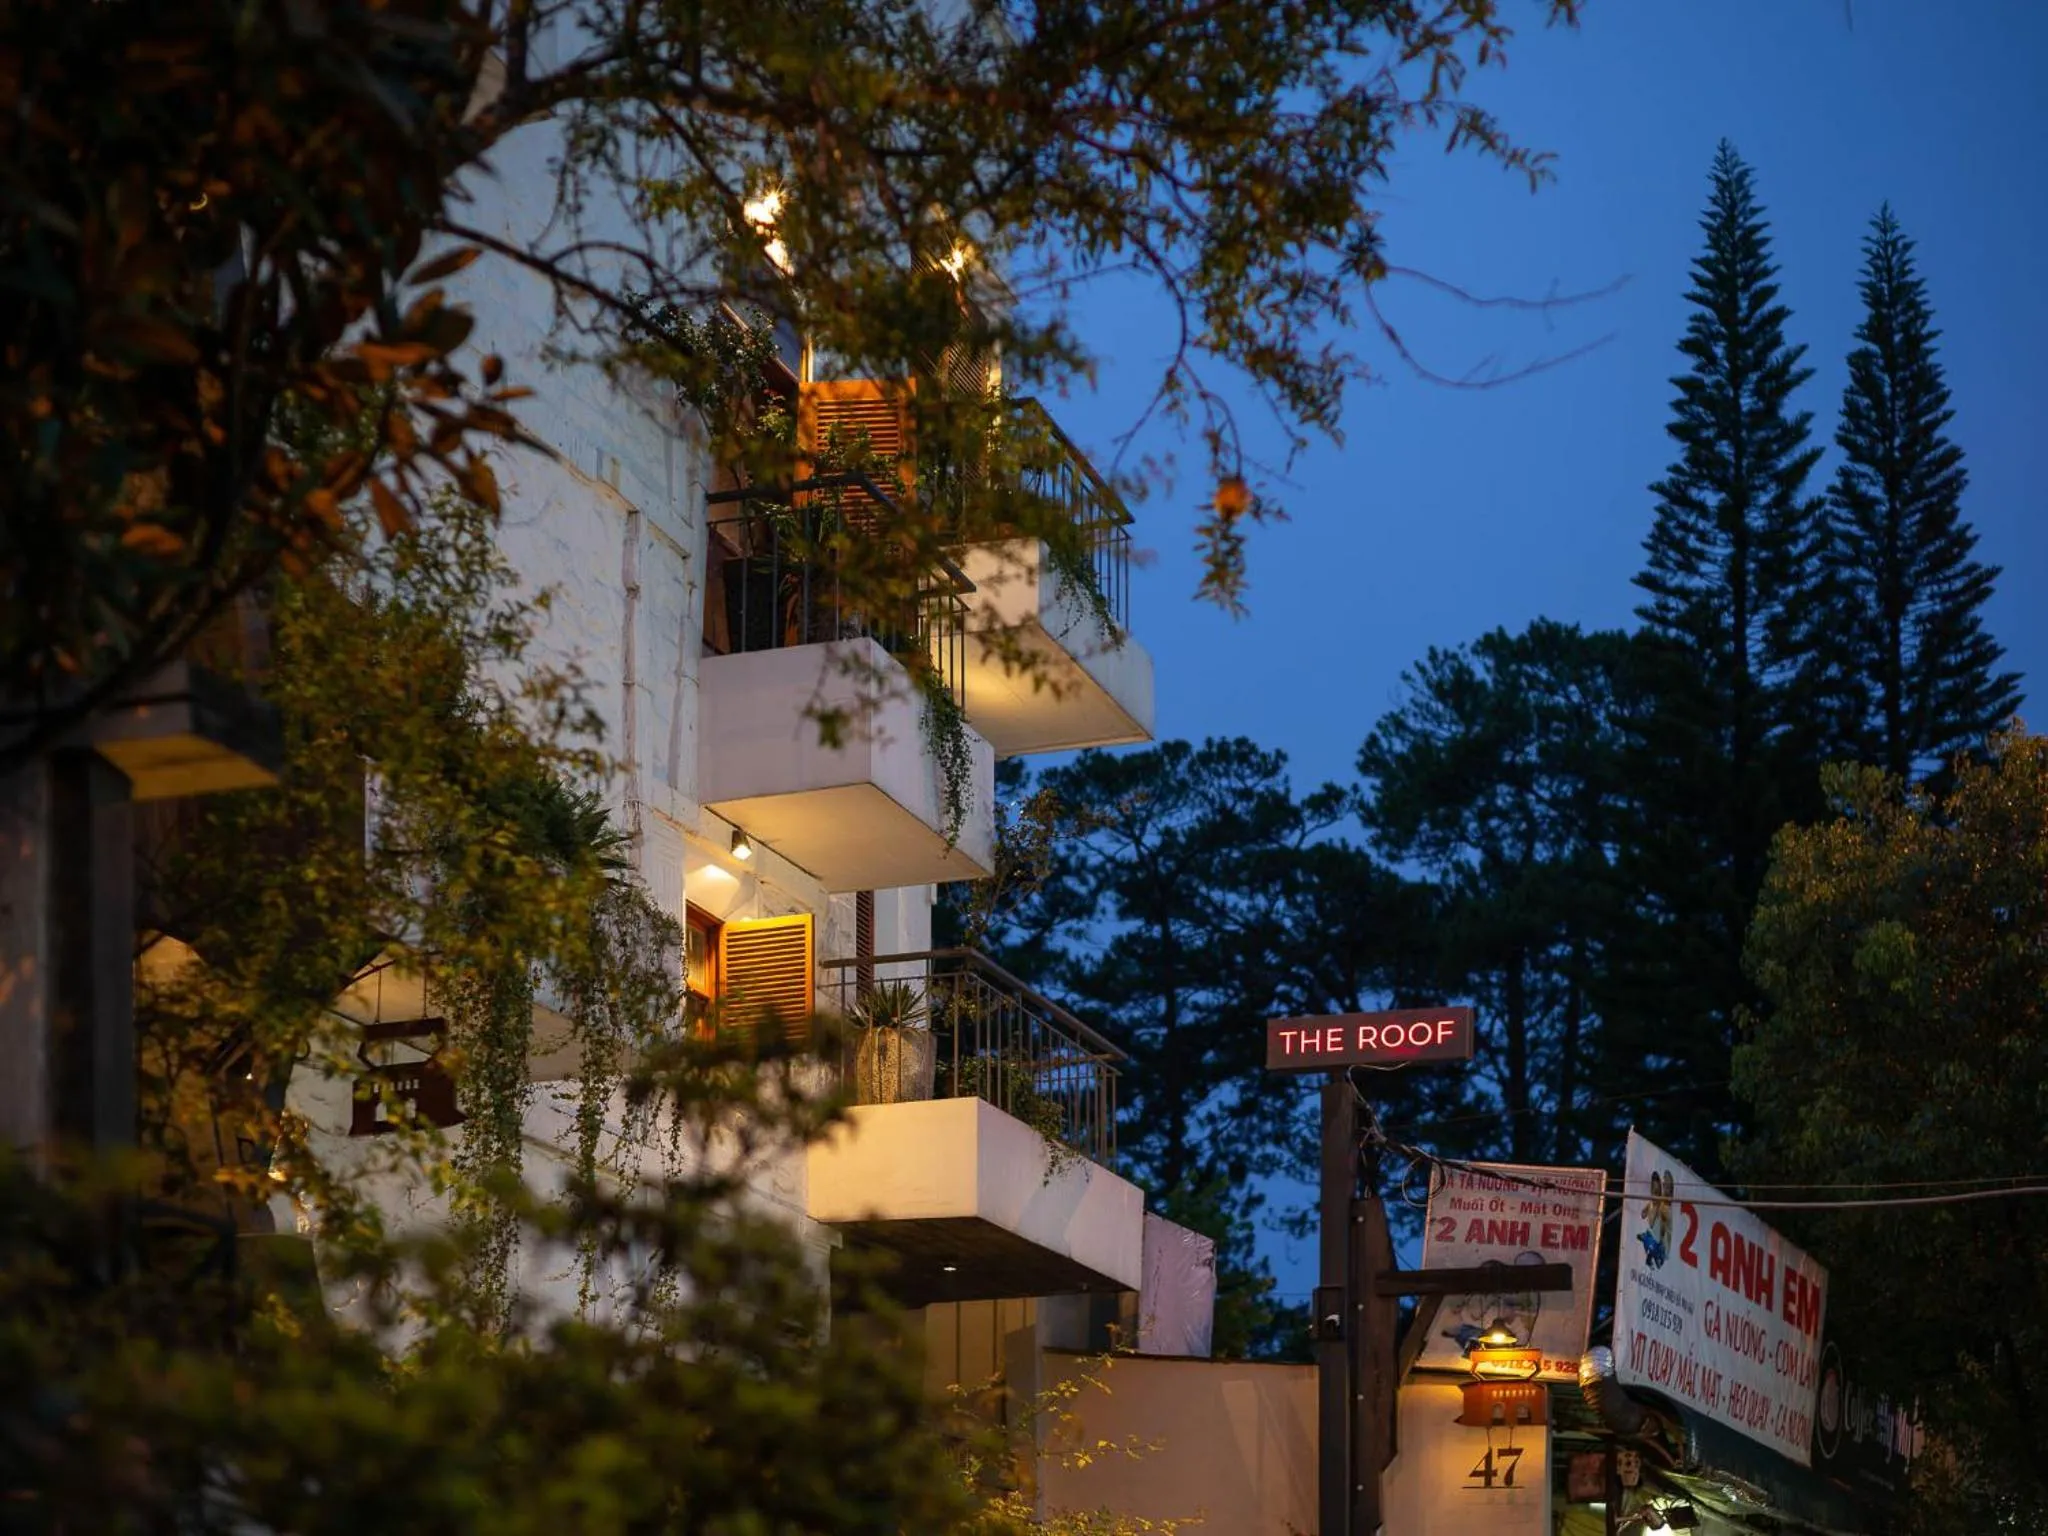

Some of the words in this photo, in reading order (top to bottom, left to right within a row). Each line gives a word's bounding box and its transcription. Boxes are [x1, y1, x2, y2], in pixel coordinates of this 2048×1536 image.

[1279, 1028, 1344, 1054] THE
[1358, 1020, 1455, 1050] ROOF
[1552, 1203, 1580, 1219] Ong
[1435, 1217, 1458, 1243] 2
[1464, 1218, 1531, 1248] ANH
[1540, 1222, 1591, 1251] EM
[1679, 1201, 1699, 1268] 2
[1709, 1221, 1775, 1313] ANH
[1783, 1266, 1820, 1341] EM
[1468, 1447, 1525, 1487] 47
